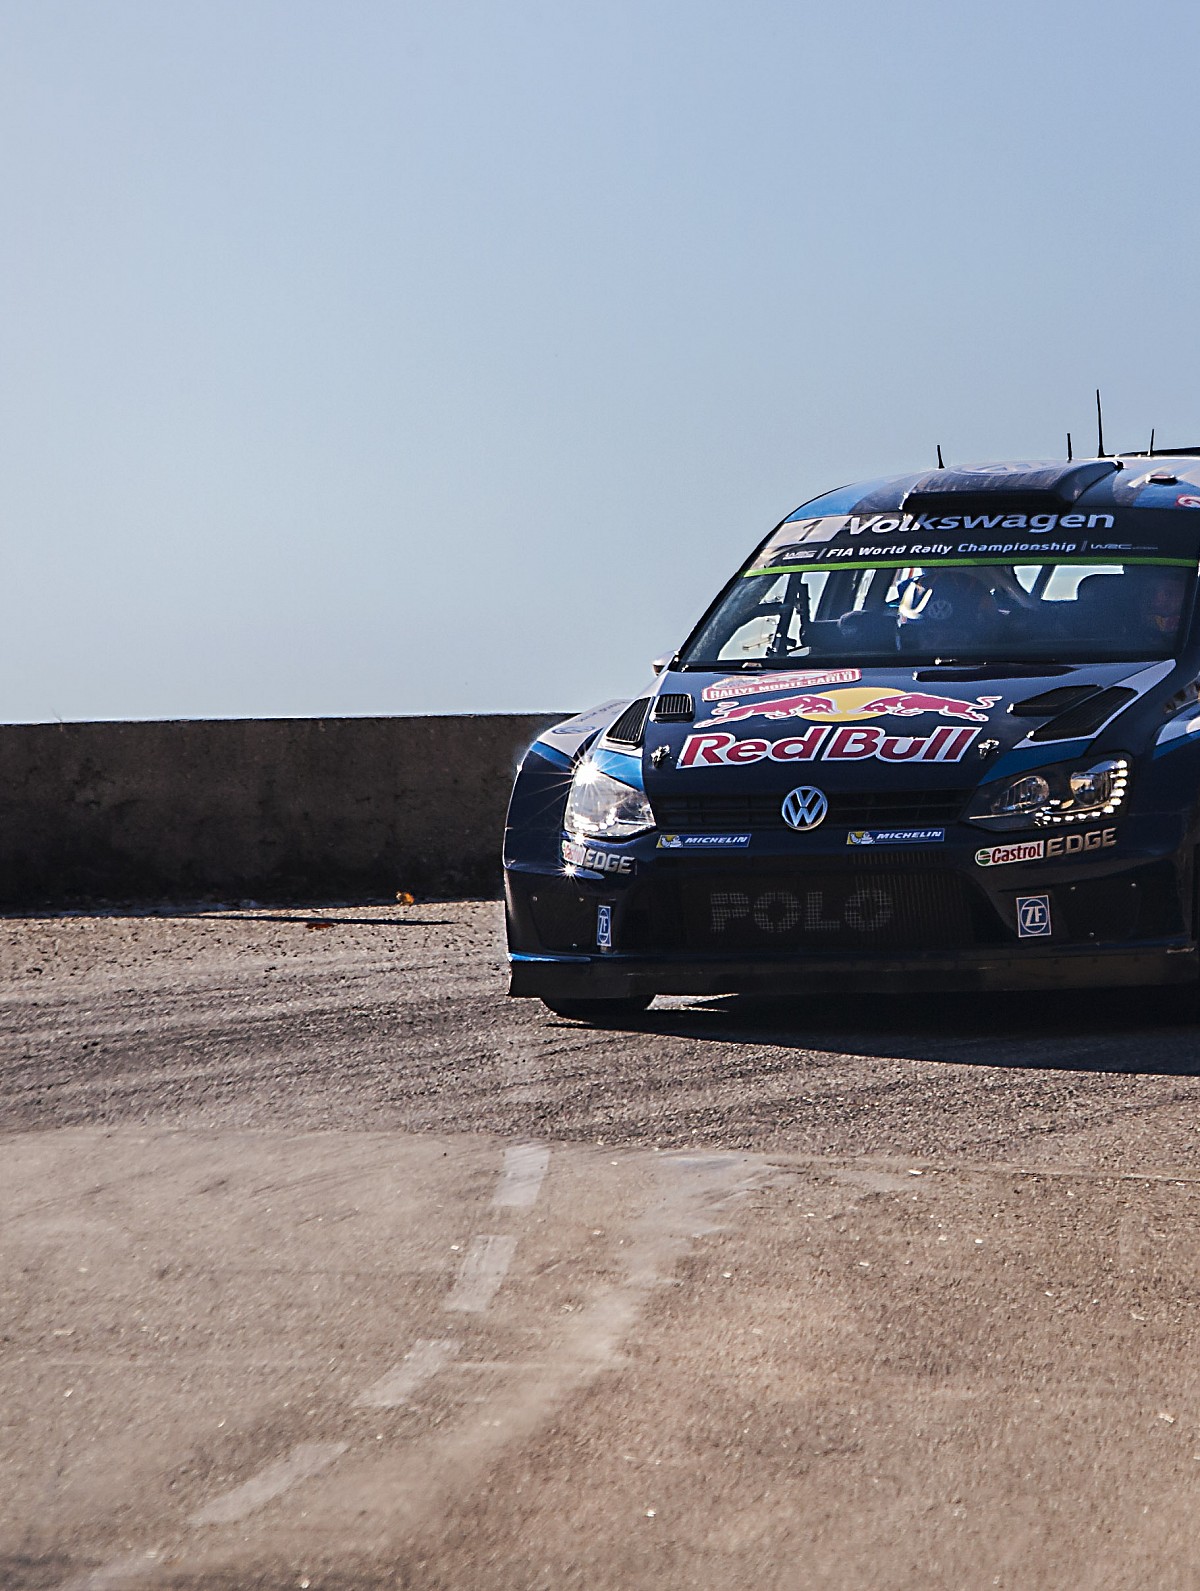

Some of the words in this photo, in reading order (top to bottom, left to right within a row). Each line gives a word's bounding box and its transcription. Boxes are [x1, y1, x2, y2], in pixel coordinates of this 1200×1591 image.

[799, 519, 823, 542] 1
[849, 513, 1115, 535] Volkswagen
[826, 548, 854, 558] FIA
[858, 545, 905, 556] World
[910, 544, 953, 555] Rally
[957, 542, 1077, 554] Championship
[710, 687, 756, 699] RALLYE
[679, 725, 831, 768] Red
[823, 726, 981, 762] Bull
[684, 836, 748, 845] MICHELIN
[876, 830, 942, 841] MICHELIN
[991, 842, 1042, 864] Castrol
[1046, 827, 1117, 858] EDGE
[584, 848, 636, 875] EDGE
[709, 888, 894, 933] POLO
[1021, 905, 1047, 927] ZF
